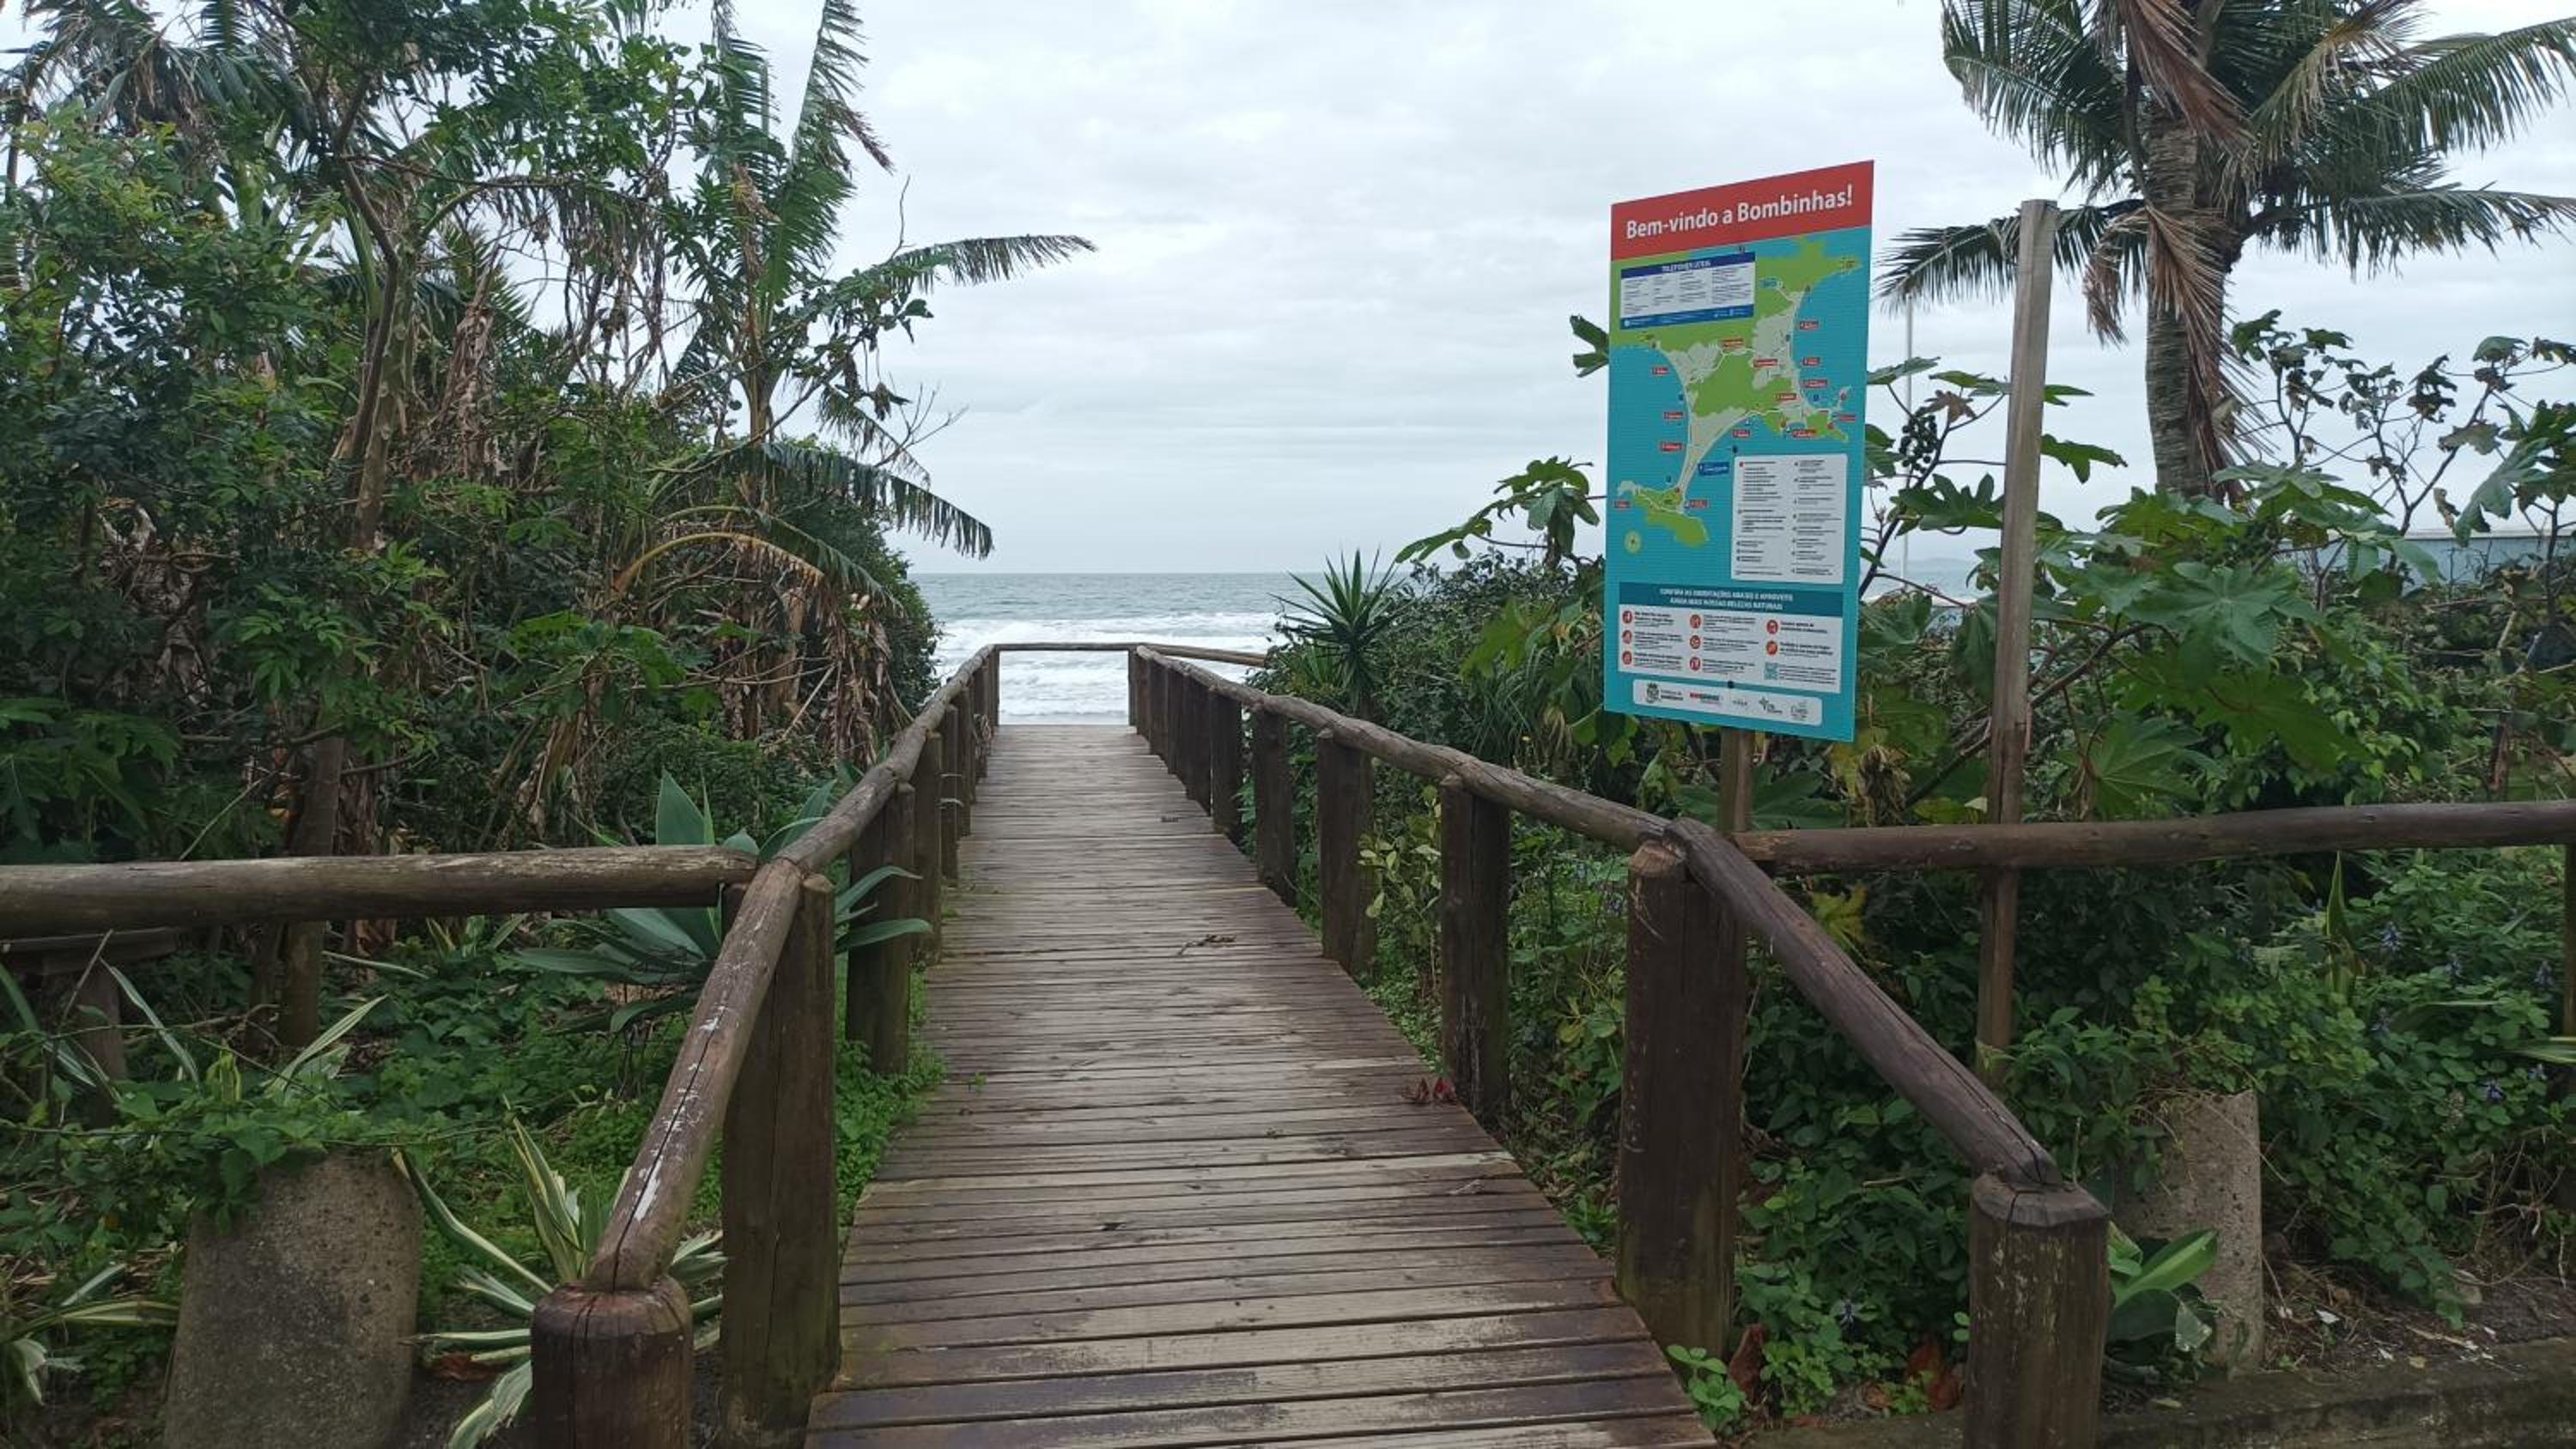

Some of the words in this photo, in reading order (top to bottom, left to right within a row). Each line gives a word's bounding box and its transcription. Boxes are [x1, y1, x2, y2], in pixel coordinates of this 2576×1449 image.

[1626, 208, 1717, 239] Bem-vindo
[1722, 210, 1732, 224] a
[1737, 184, 1853, 221] Bombinhas!
